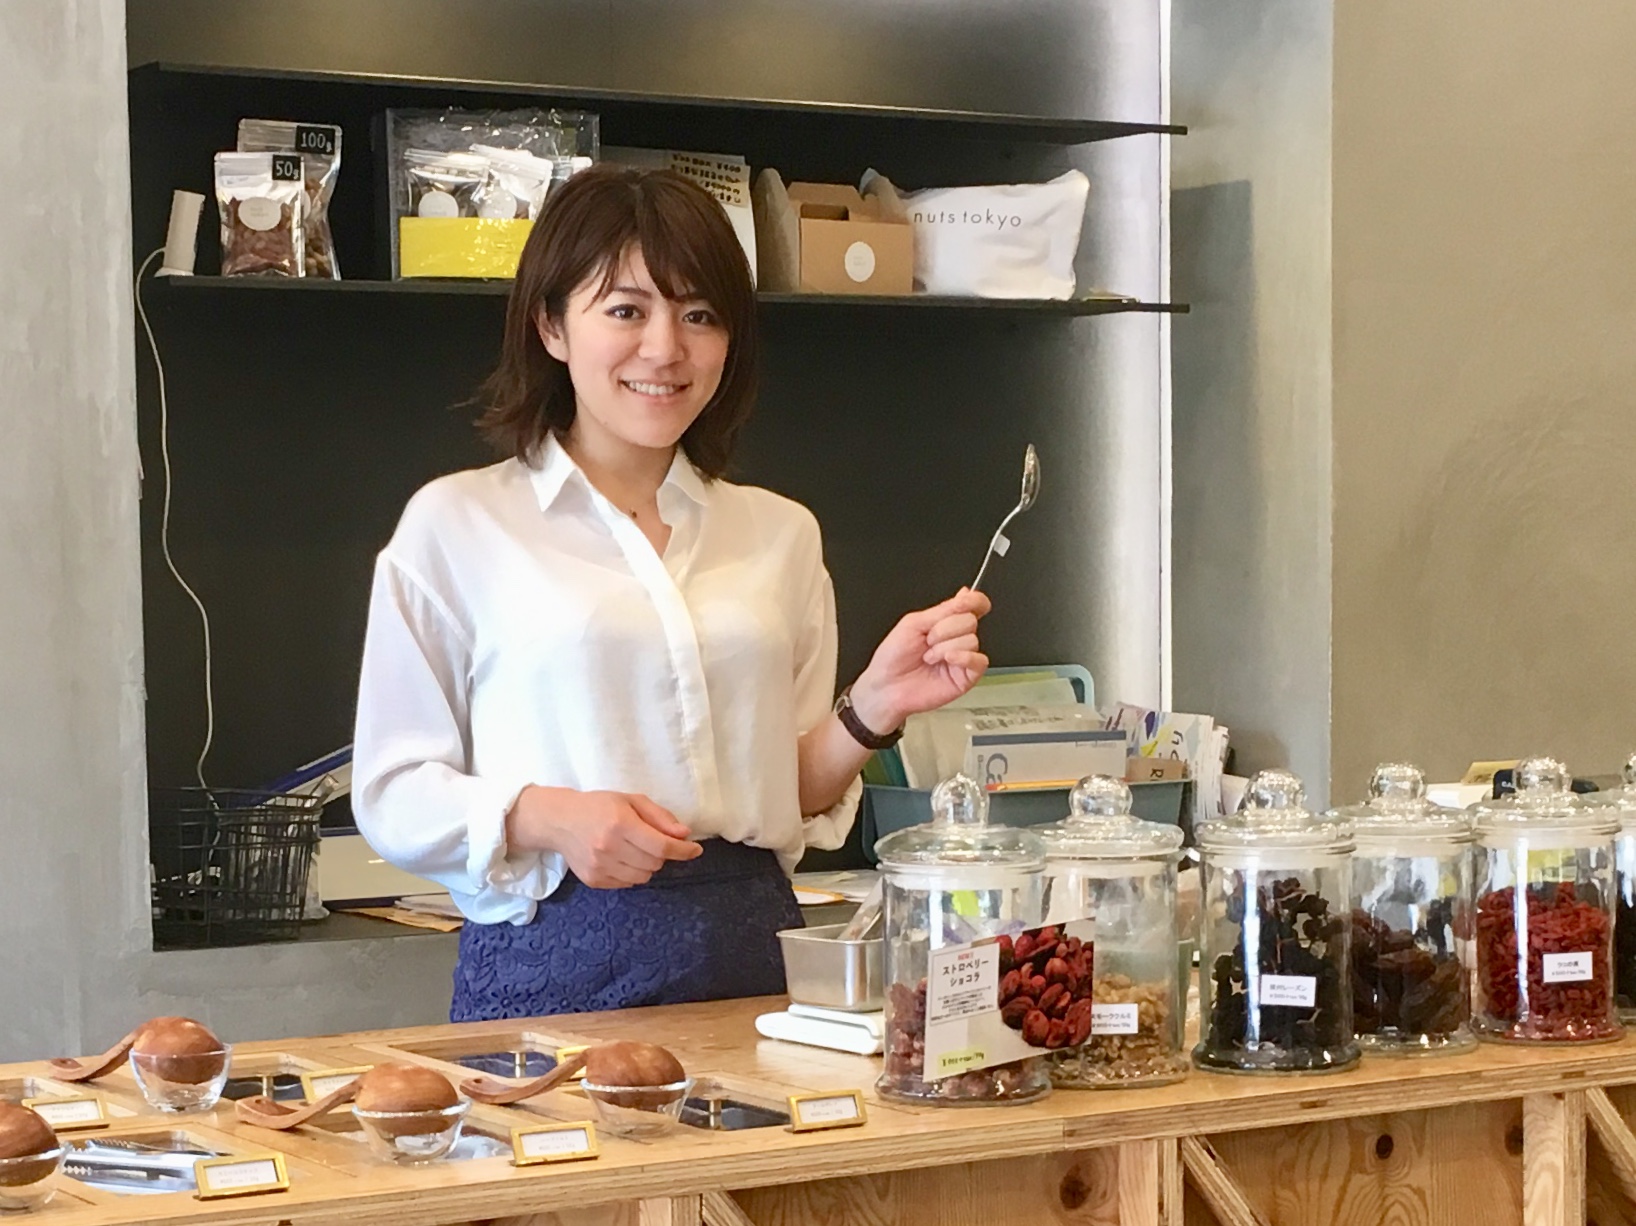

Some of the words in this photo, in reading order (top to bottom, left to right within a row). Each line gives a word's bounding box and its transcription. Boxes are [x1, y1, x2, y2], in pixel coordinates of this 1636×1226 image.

[300, 132, 332, 153] 100g
[275, 161, 299, 179] 50g
[913, 211, 955, 224] nuts
[963, 208, 1022, 230] tokyo
[942, 958, 989, 976] ストロベリー
[950, 971, 980, 987] ショコラ
